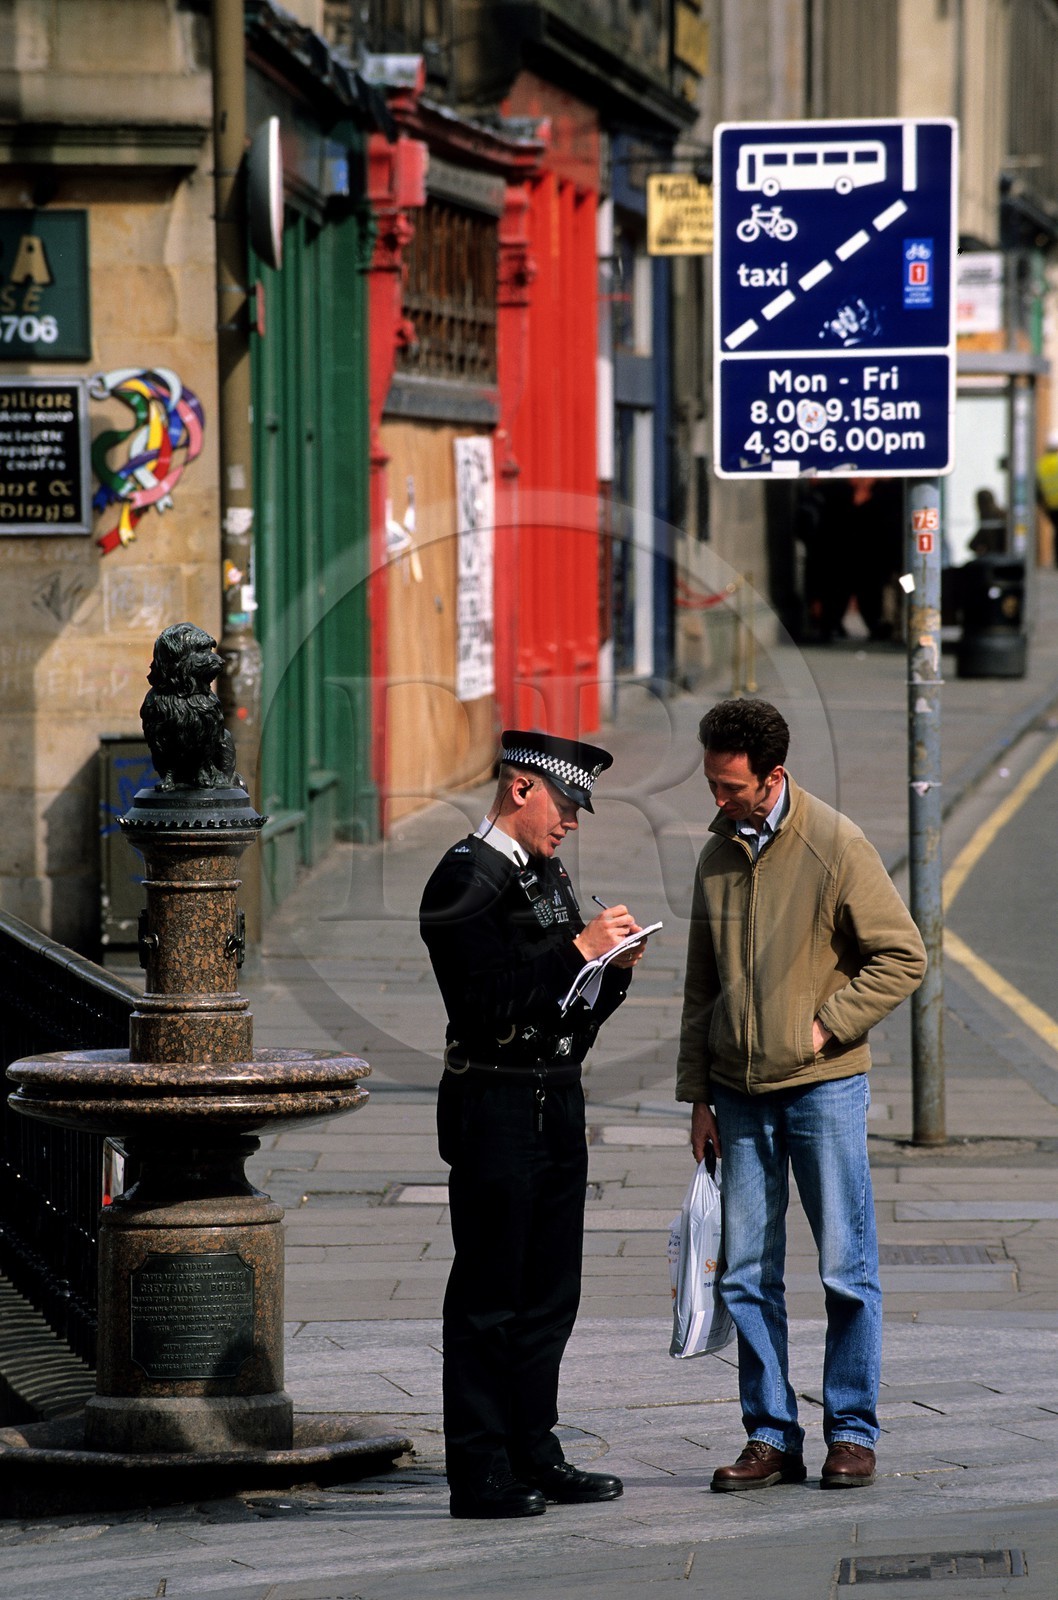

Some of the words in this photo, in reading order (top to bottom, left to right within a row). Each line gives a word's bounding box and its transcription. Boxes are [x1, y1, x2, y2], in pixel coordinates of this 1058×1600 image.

[736, 261, 788, 287] taxi
[914, 266, 923, 280] 1
[0, 314, 59, 344] 706
[768, 369, 827, 394] Mon
[838, 377, 850, 385] -
[862, 366, 899, 391] Fri
[749, 396, 921, 426] 8.09.15am
[743, 427, 926, 455] 4.30-6.00pm
[913, 509, 938, 530] 75
[922, 536, 929, 550] 1
[178, 1262, 212, 1270] TRIBUTE
[140, 1283, 201, 1293] GREYFRIARS
